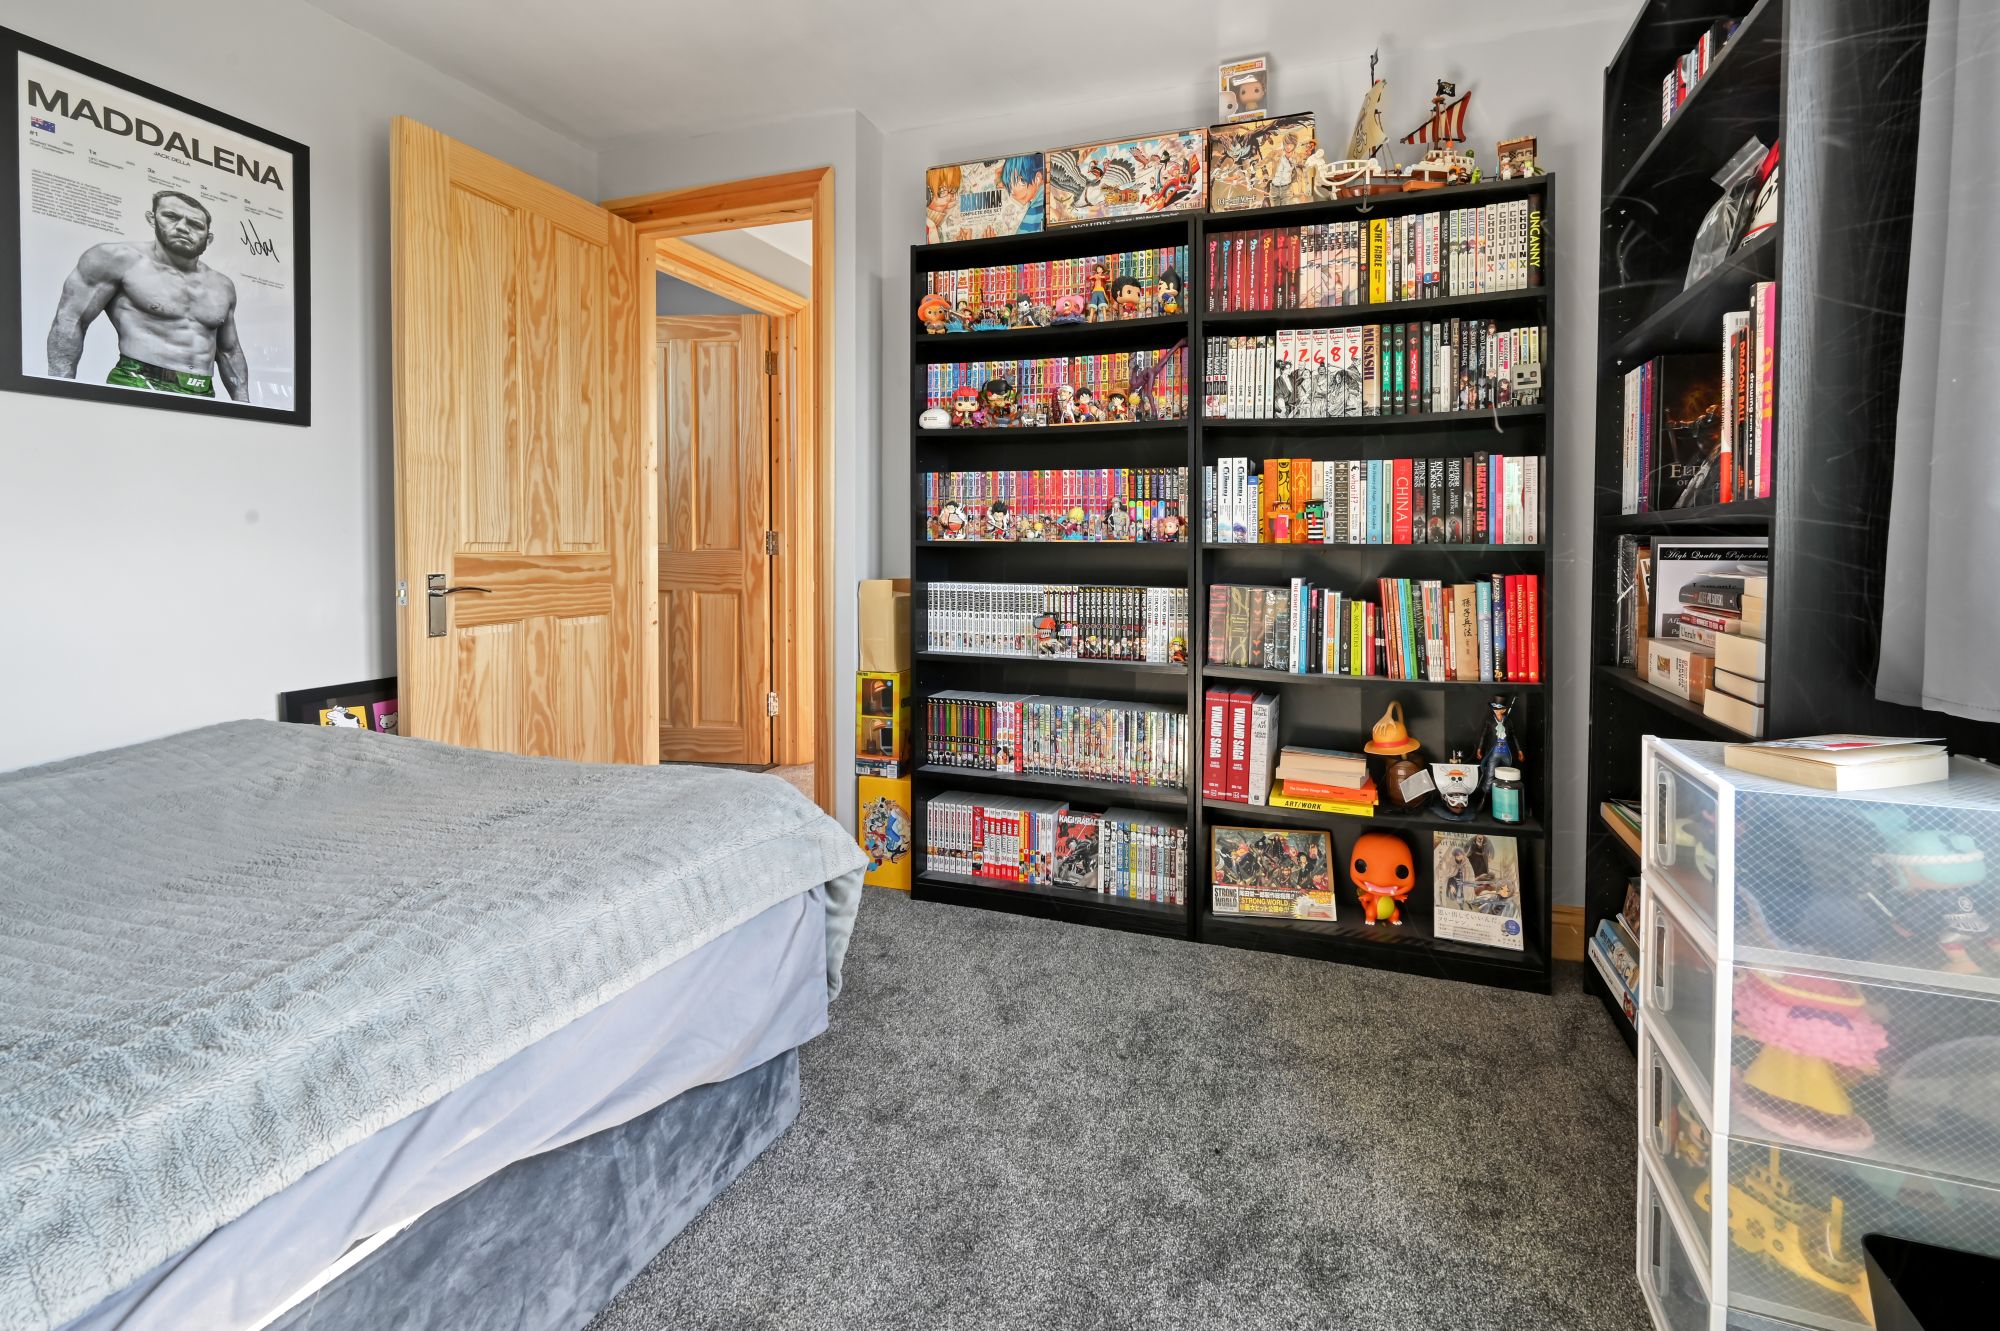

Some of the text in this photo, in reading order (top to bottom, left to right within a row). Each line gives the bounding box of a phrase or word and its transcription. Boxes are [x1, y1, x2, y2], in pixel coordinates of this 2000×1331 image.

[27, 79, 284, 191] MADDALENA
[153, 151, 170, 161] JACK
[1529, 211, 1541, 268] UNCANNY
[1374, 228, 1382, 266] THE FABLE
[1487, 264, 1494, 272] X
[1498, 261, 1505, 270] X
[1509, 260, 1516, 269] X
[1519, 260, 1526, 268] X
[1469, 281, 1475, 289] 3
[1478, 281, 1484, 289] 4
[1313, 349, 1325, 364] 6
[1330, 346, 1341, 362] 8
[1363, 327, 1375, 381] MUSASHI
[1351, 474, 1359, 504] what if?
[1396, 476, 1409, 522] CHINA
[1476, 466, 1486, 531] GREATEST HITS
[1664, 550, 1687, 560] High
[1690, 550, 1722, 560] Quality
[1210, 706, 1223, 758] VINLAND SAGA
[1232, 707, 1246, 760] VINLAND SAGA
[1285, 800, 1322, 810] ART/WORK
[1214, 888, 1237, 897] STRONG
[1216, 897, 1237, 907] WORLD
